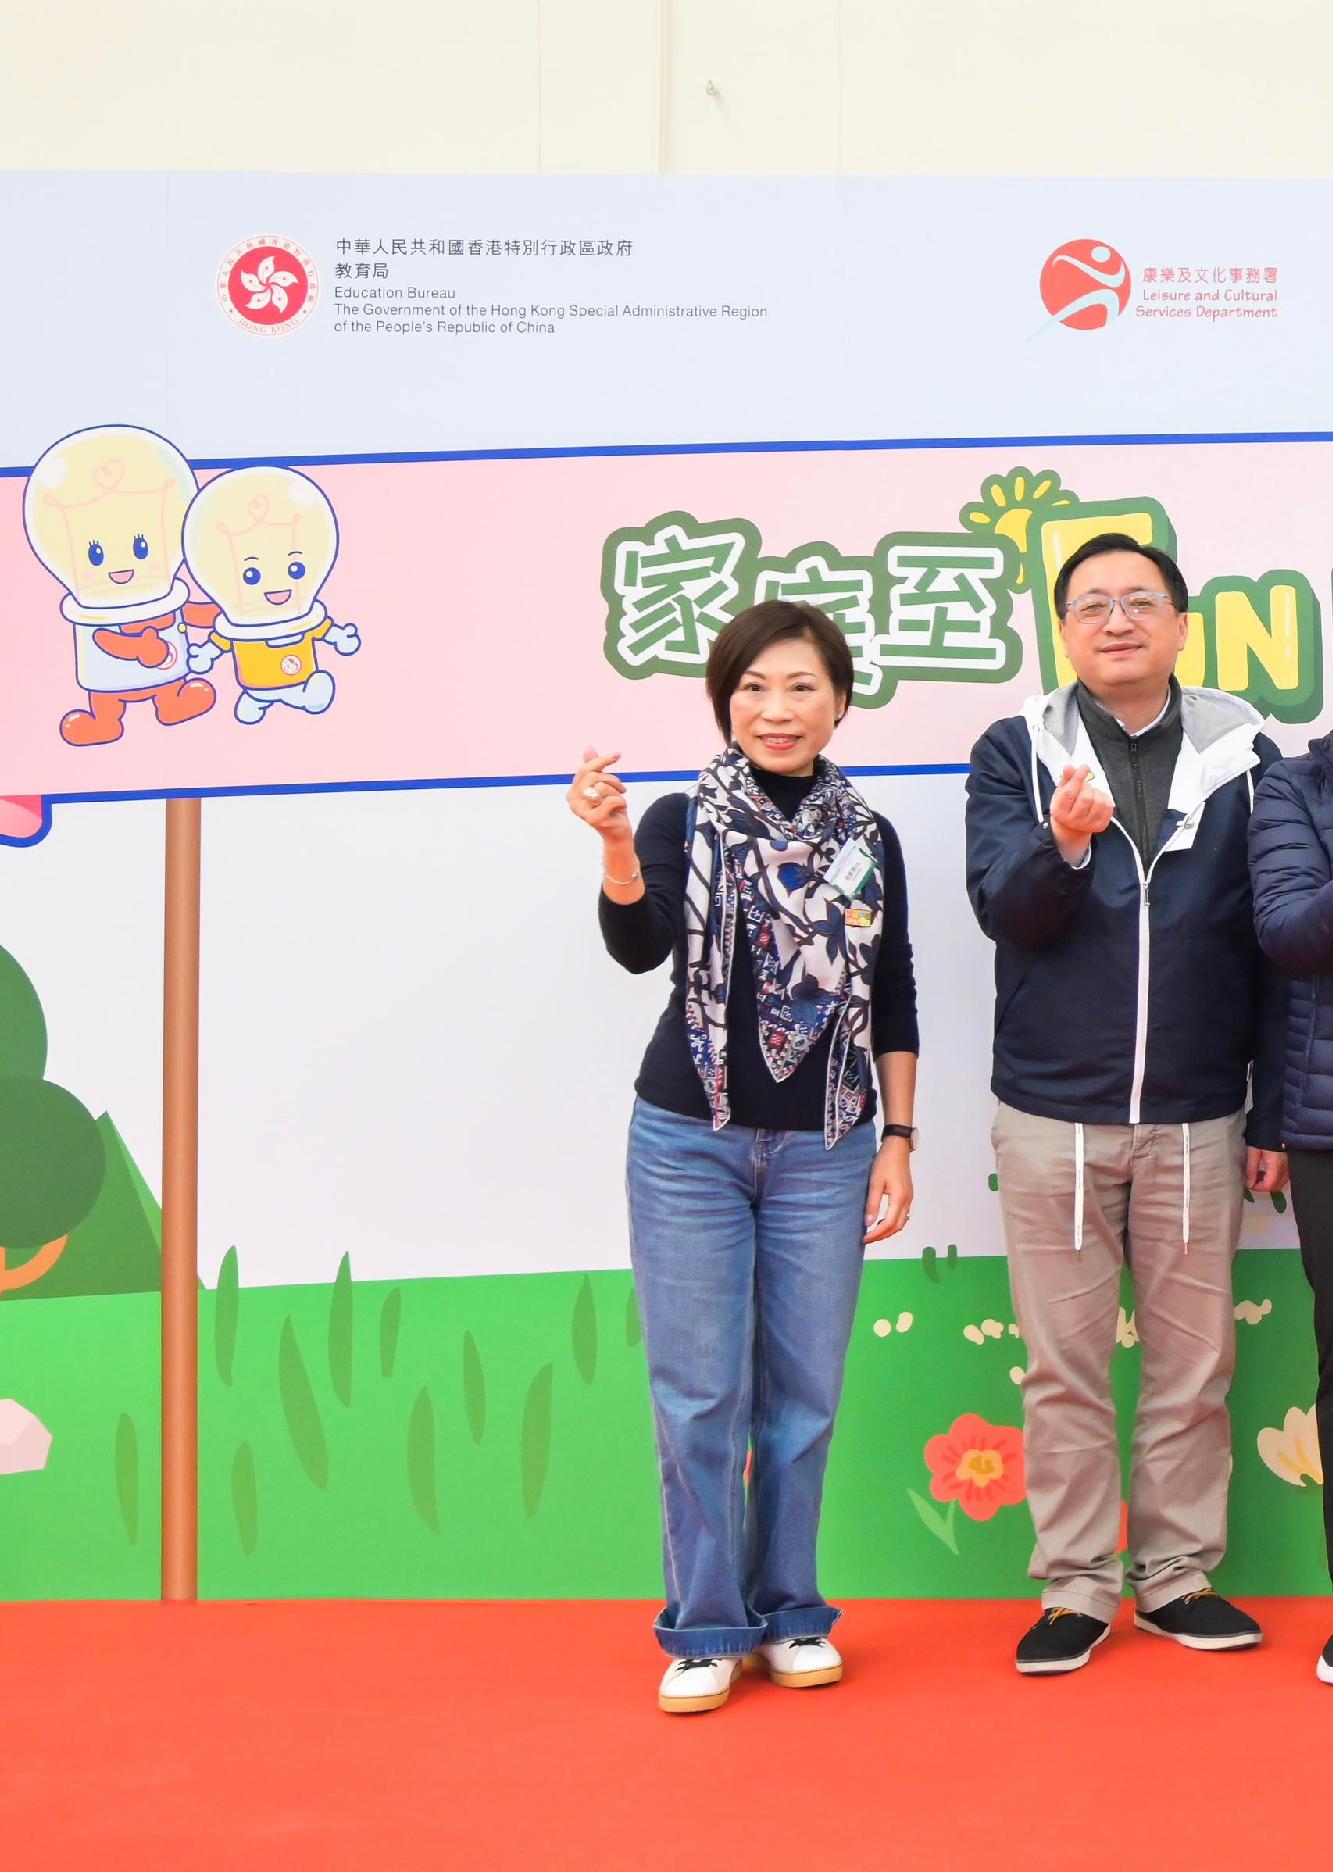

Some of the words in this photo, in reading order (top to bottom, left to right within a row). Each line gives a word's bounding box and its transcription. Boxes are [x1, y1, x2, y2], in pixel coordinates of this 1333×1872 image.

[336, 238, 633, 256] 中華人民共和國香港特別行政區政府
[334, 262, 389, 279] 教育局
[1142, 266, 1279, 284] 康樂及文化事務署
[334, 287, 403, 299] Education
[407, 287, 456, 299] Bureau
[1143, 289, 1191, 301] Leisure
[1194, 289, 1220, 301] and
[1224, 289, 1278, 302] Cultural
[334, 303, 360, 316] The
[363, 303, 446, 316] Government
[449, 303, 463, 316] of
[466, 303, 487, 316] the
[491, 304, 526, 319] Hong
[531, 304, 565, 319] Kong
[569, 304, 618, 319] Special
[622, 305, 717, 317] Administrative
[721, 305, 768, 320] Region
[1136, 305, 1192, 317] Services
[1196, 305, 1278, 323] Department
[334, 321, 347, 333] of
[351, 321, 372, 333] the
[376, 321, 433, 335] People's
[437, 321, 496, 335] Republic
[500, 321, 513, 333] of
[516, 321, 555, 334] China
